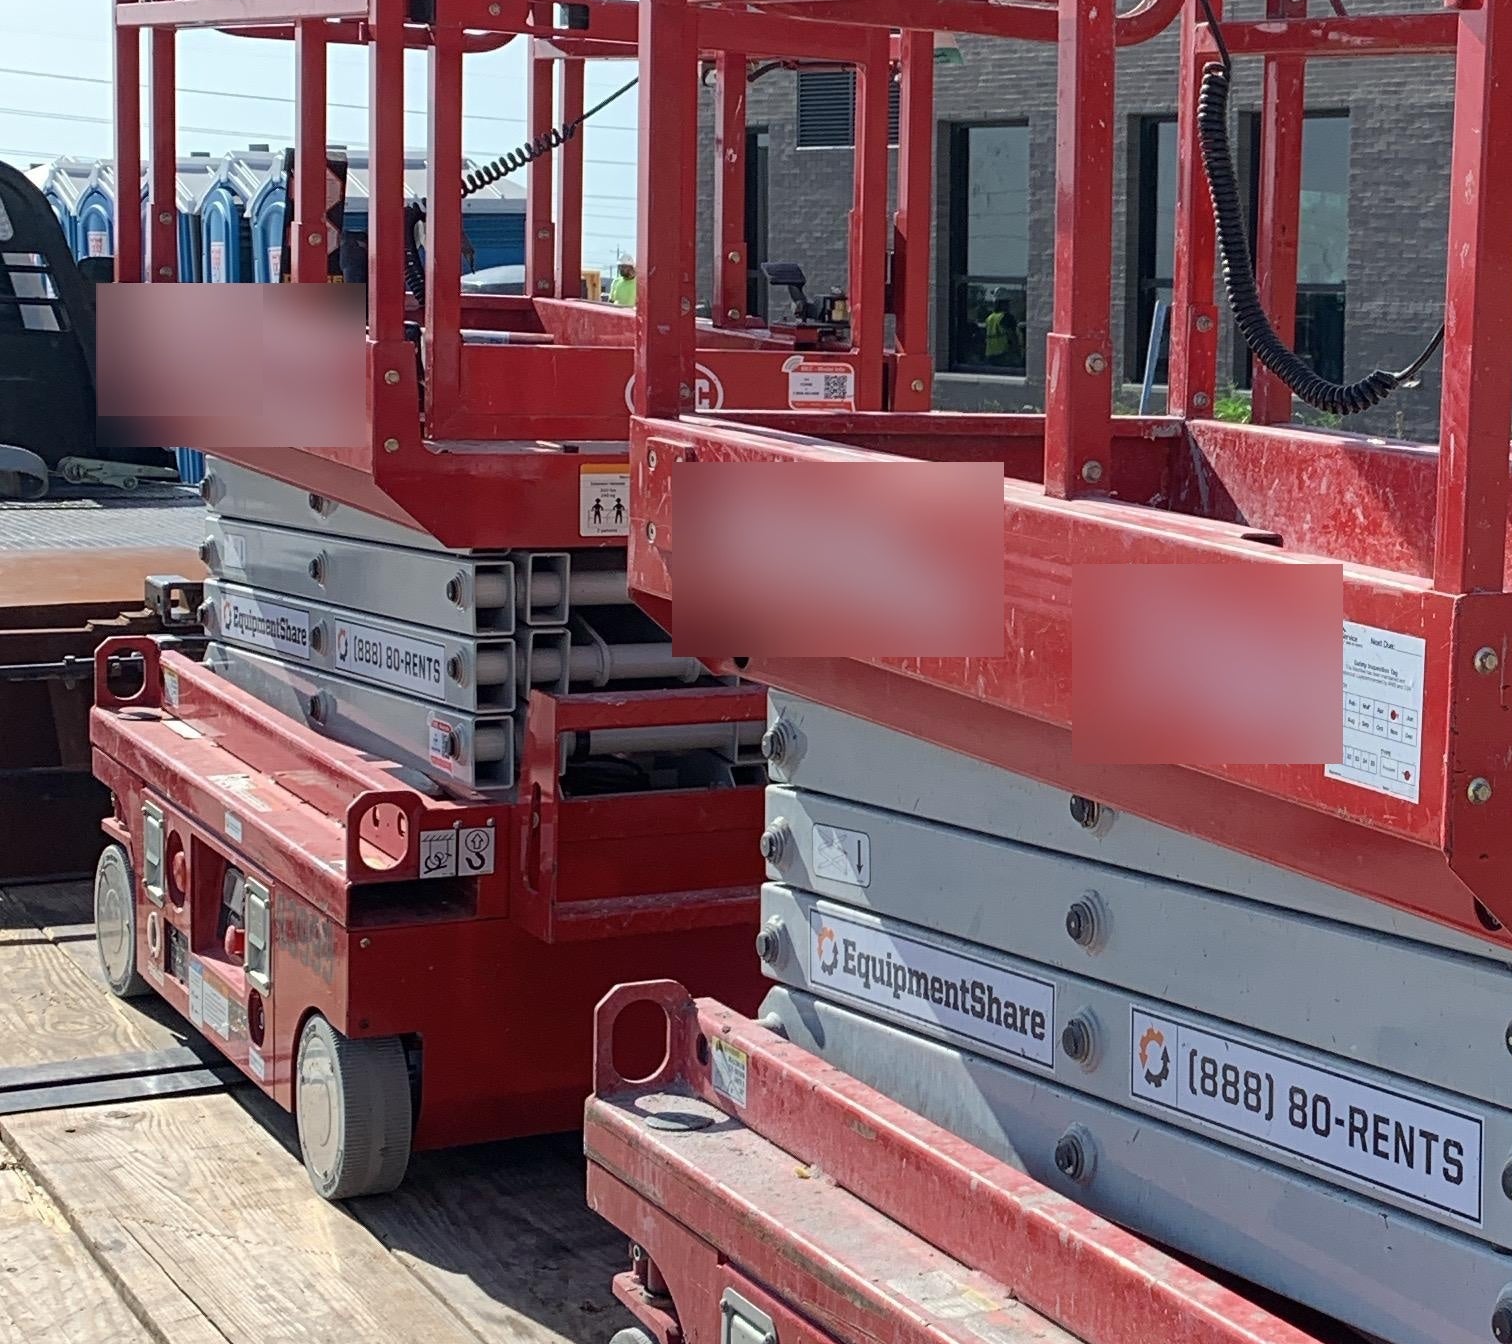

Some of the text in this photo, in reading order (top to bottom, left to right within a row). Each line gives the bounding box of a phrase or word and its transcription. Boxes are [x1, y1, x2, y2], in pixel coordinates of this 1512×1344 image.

[233, 605, 307, 647] EquipmentShare
[353, 635, 441, 684] (888) 80-RENTS
[842, 937, 1046, 1041] EquipmentShare
[1188, 1048, 1464, 1186] (888) 80-RENTS
